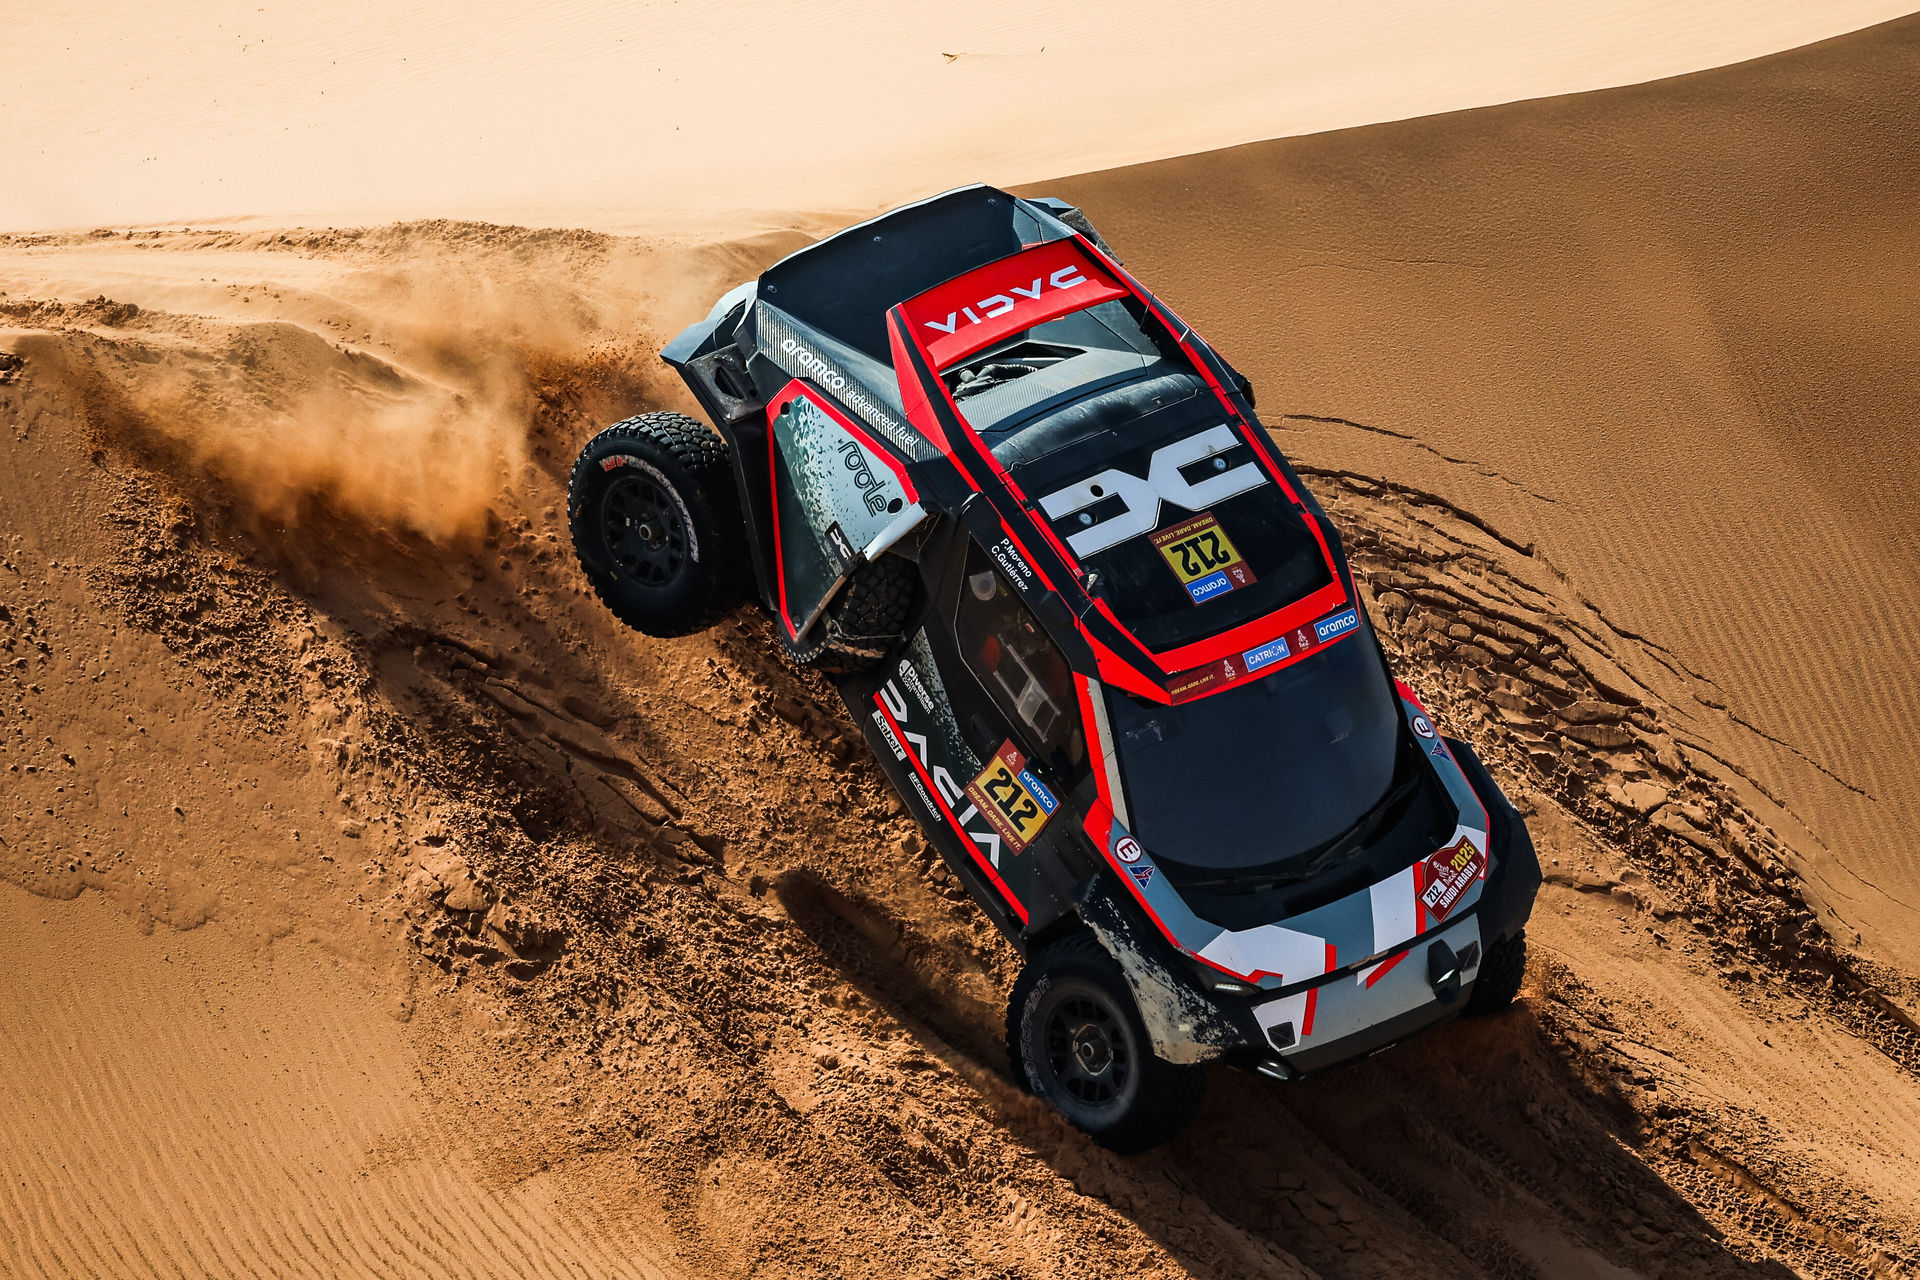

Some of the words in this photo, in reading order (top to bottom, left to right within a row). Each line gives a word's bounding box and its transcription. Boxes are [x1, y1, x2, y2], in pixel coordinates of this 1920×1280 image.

[782, 339, 845, 389] aramco
[847, 390, 898, 431] advanced
[895, 426, 920, 447] fuel
[1191, 517, 1213, 529] DREAM.
[991, 545, 1028, 592] C.Gutiérrez
[1000, 537, 1032, 577] P.Moreno
[1169, 531, 1231, 576] 212
[1192, 577, 1227, 596] aramco
[1319, 614, 1356, 637] aramco
[908, 666, 934, 710] Diverse
[876, 714, 903, 756] Sabelt
[908, 772, 942, 822] BFGoodrich
[983, 767, 1038, 833] 212
[1023, 771, 1053, 808] aramco
[968, 786, 989, 810] DREAM.
[987, 808, 1002, 828] DARE.
[1001, 828, 1015, 843] LIVE
[1119, 841, 1139, 859] E
[1426, 885, 1442, 903] 212
[1450, 842, 1475, 872] 2025
[1440, 885, 1459, 908] SAUDI
[1454, 861, 1478, 889] ARABIA
